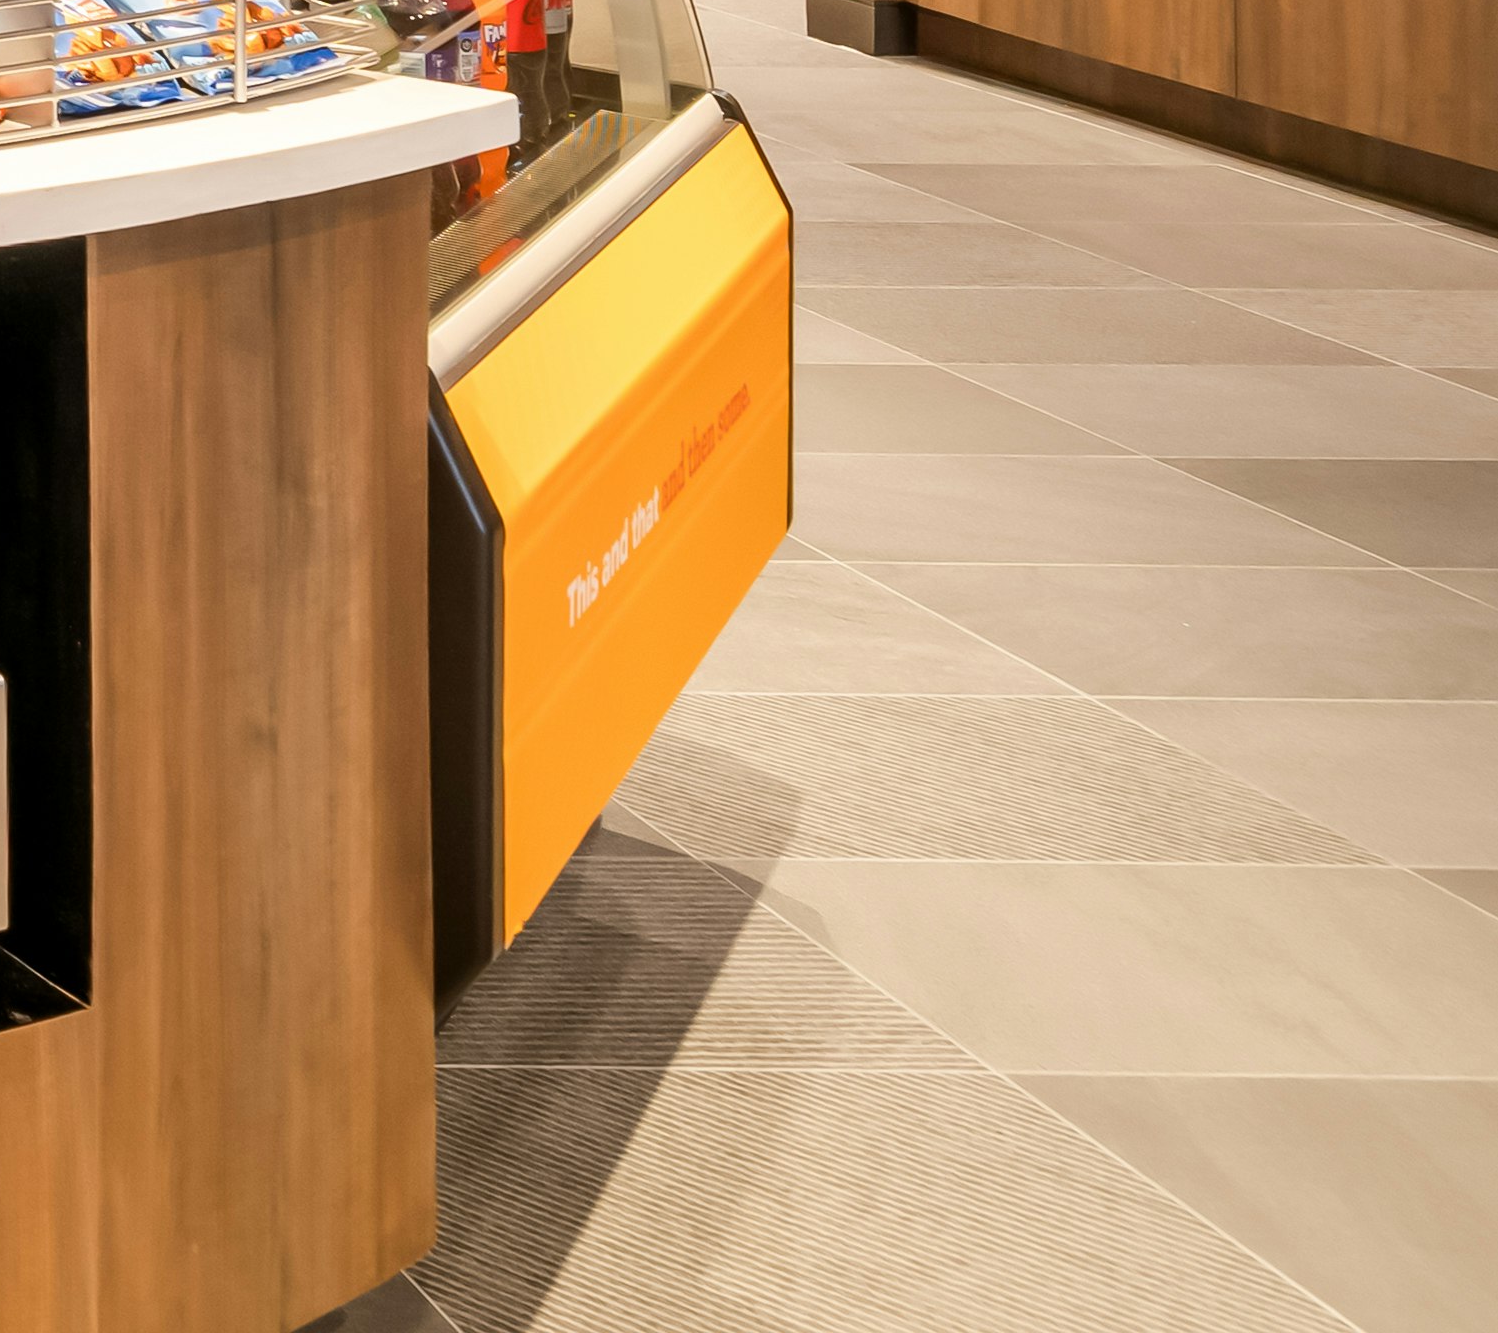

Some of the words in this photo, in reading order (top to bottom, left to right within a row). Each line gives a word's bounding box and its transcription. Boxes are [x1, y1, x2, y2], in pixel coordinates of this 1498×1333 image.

[566, 560, 600, 629] This
[601, 516, 629, 588] and
[631, 484, 660, 550] that
[661, 439, 686, 512] and
[688, 424, 716, 478] then
